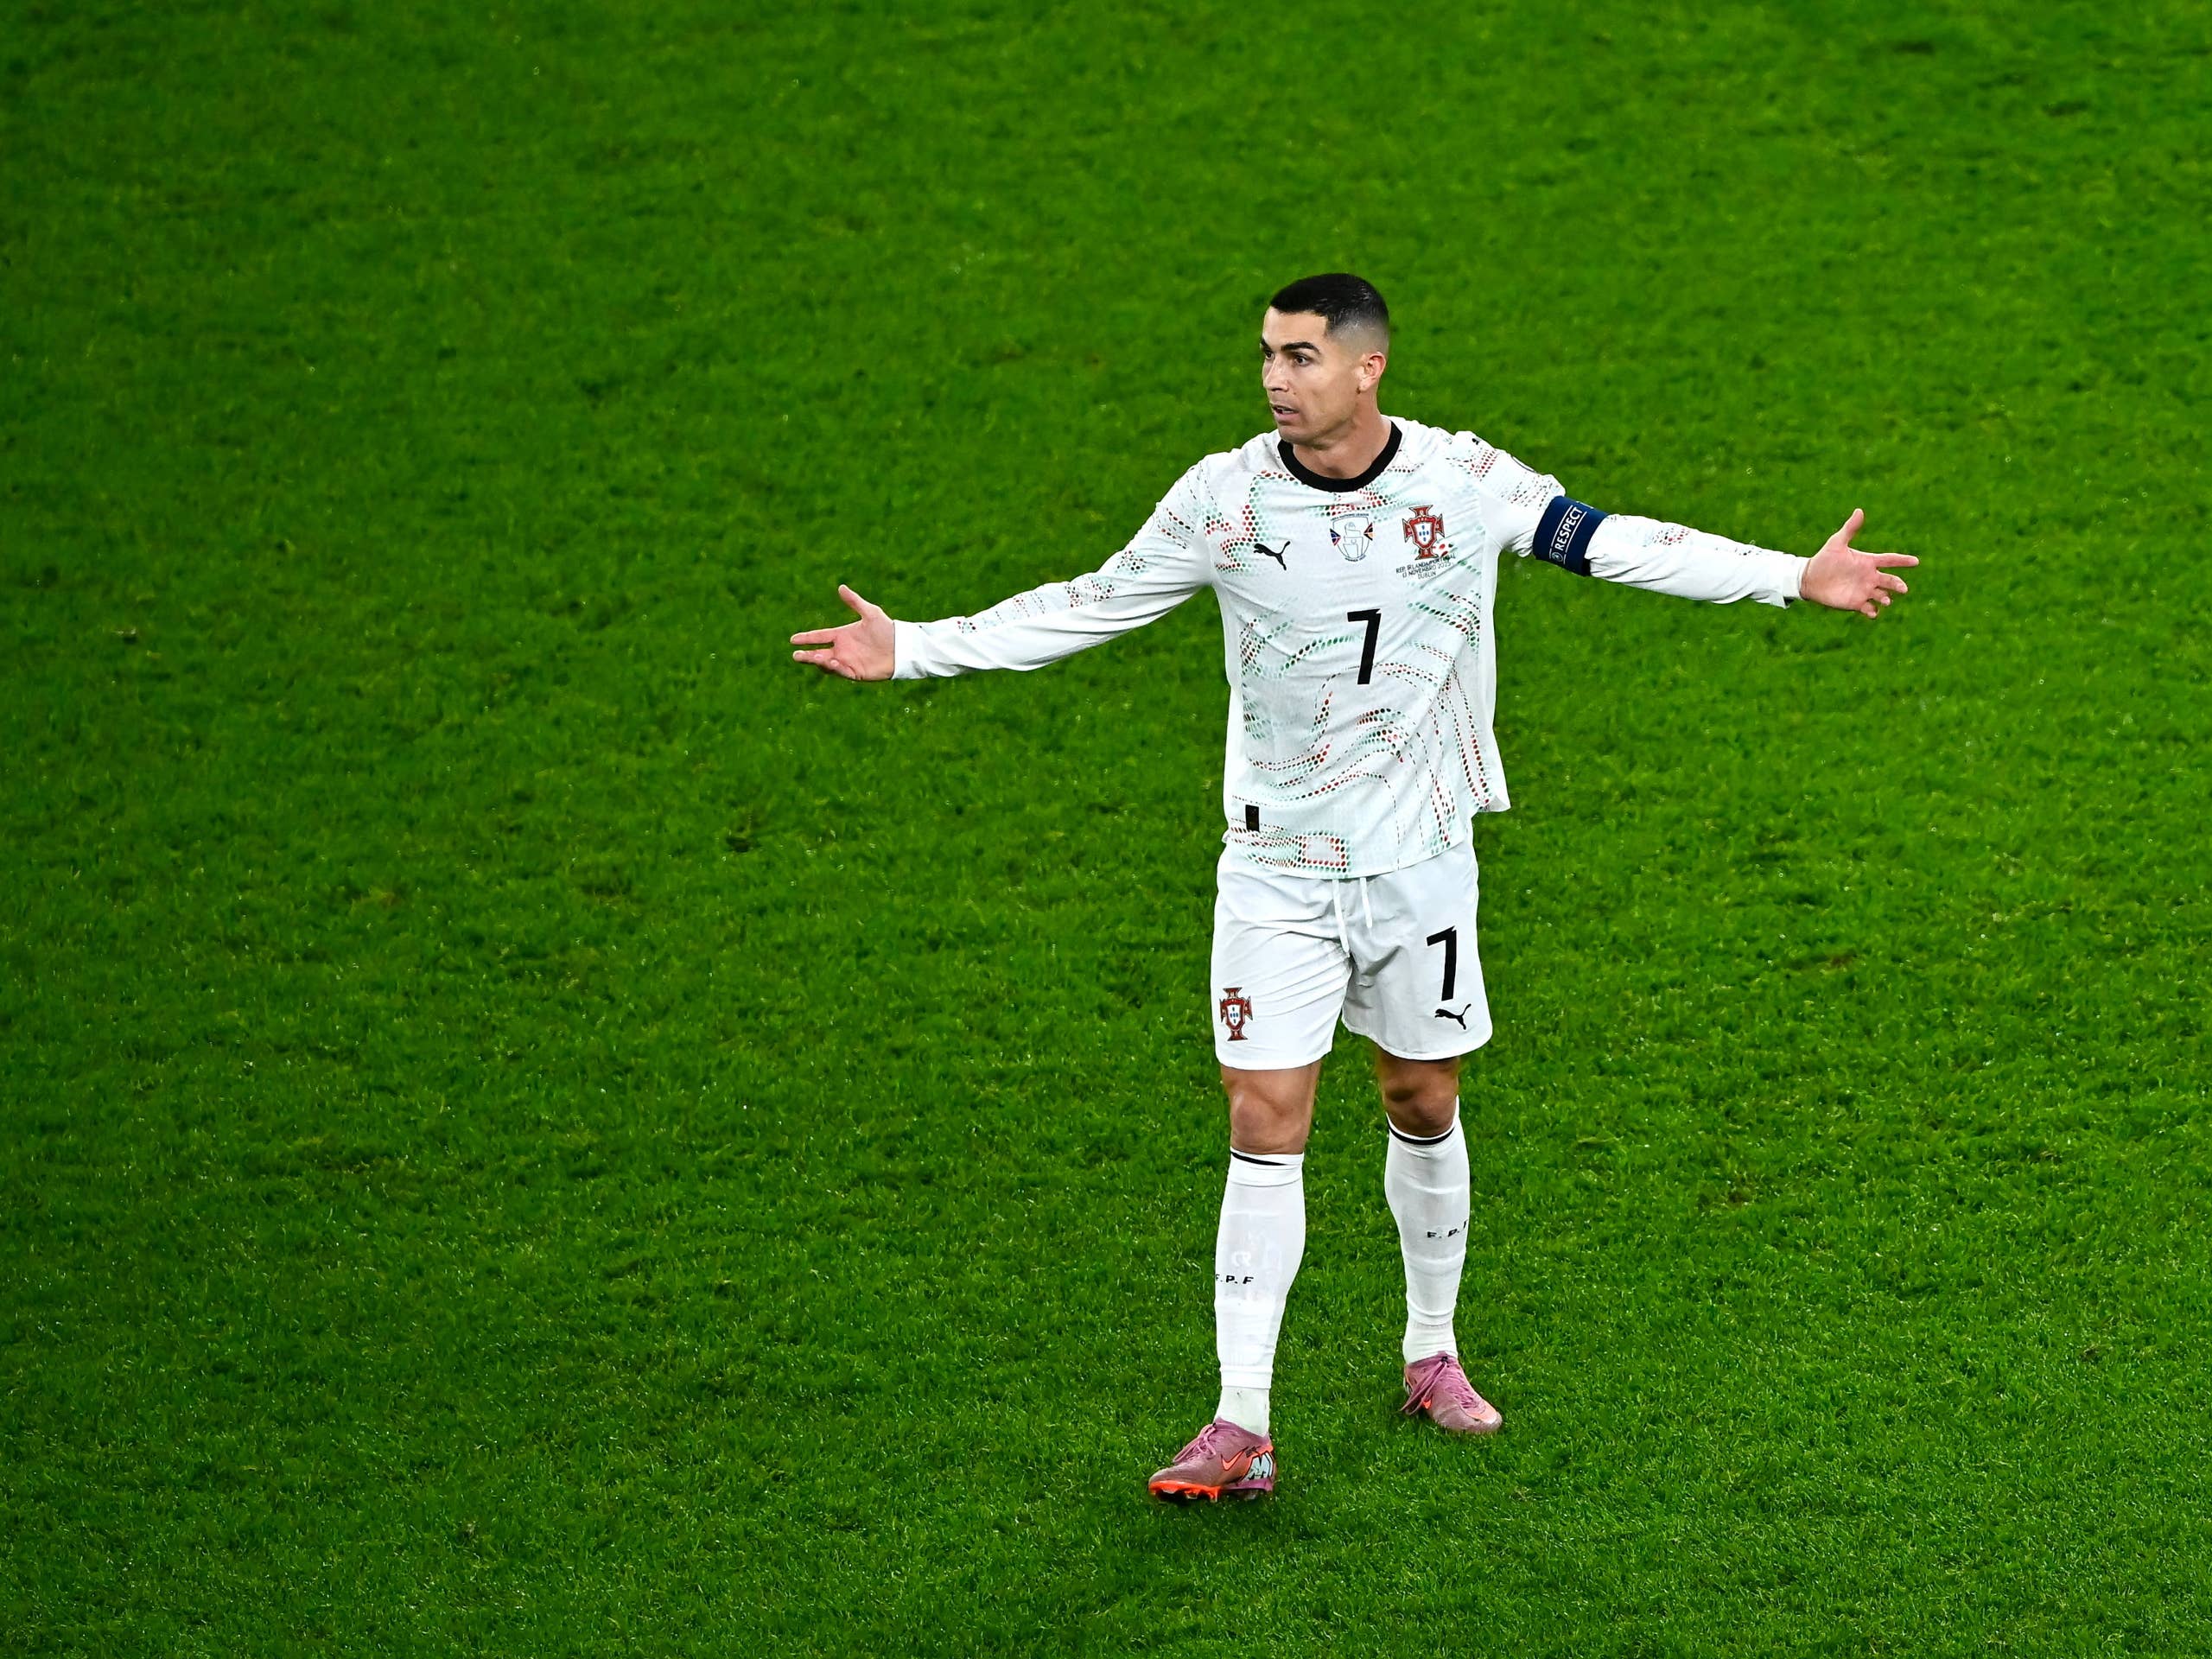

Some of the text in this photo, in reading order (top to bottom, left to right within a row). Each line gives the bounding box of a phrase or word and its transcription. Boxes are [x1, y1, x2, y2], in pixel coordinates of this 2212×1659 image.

[1554, 506, 1583, 551] RESPECT
[1347, 608, 1382, 684] 7
[1426, 925, 1457, 1001] 7
